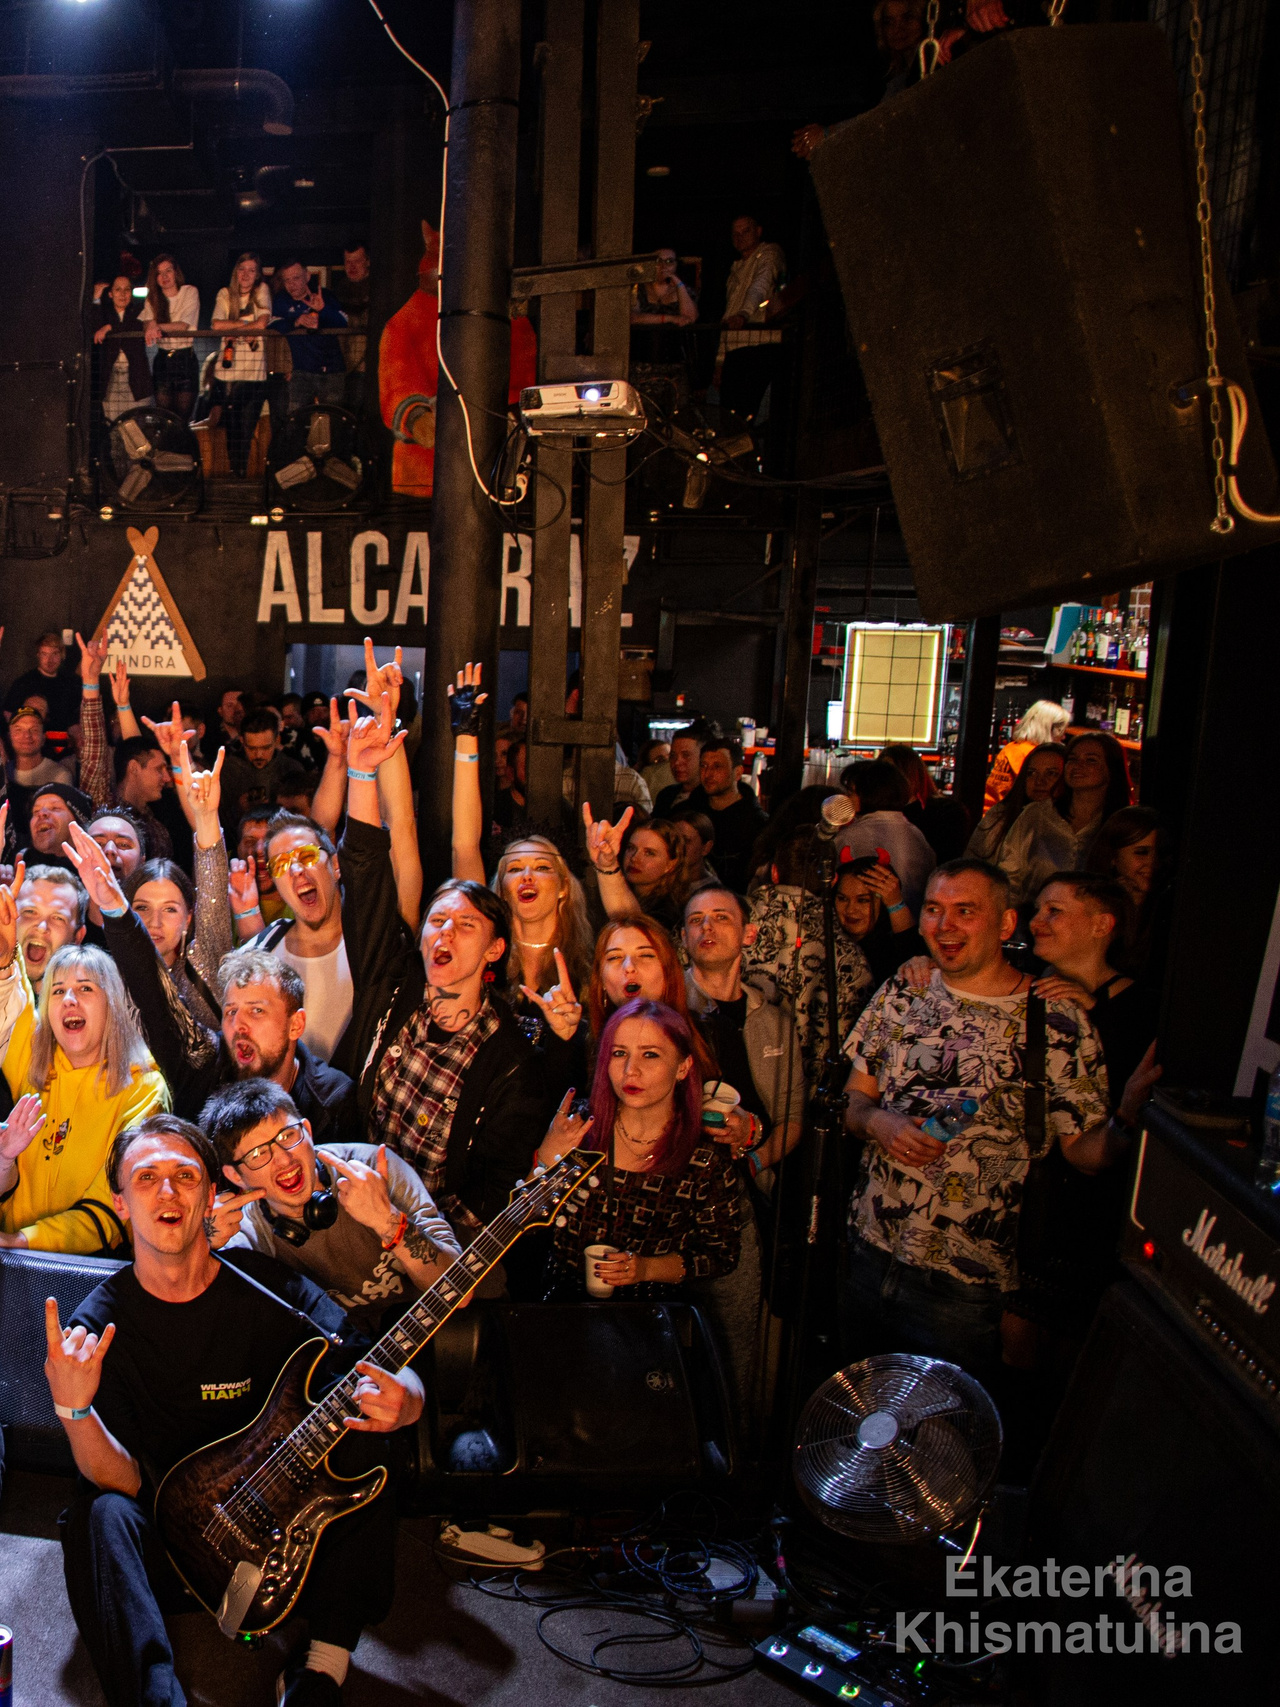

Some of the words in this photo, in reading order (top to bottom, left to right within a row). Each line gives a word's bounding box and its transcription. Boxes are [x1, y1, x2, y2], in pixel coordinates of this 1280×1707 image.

[257, 531, 640, 627] ALCAR
[1182, 1208, 1276, 1314] Marshall
[200, 1377, 251, 1390] WILDWAYS
[201, 1384, 251, 1400] ПАНЧ
